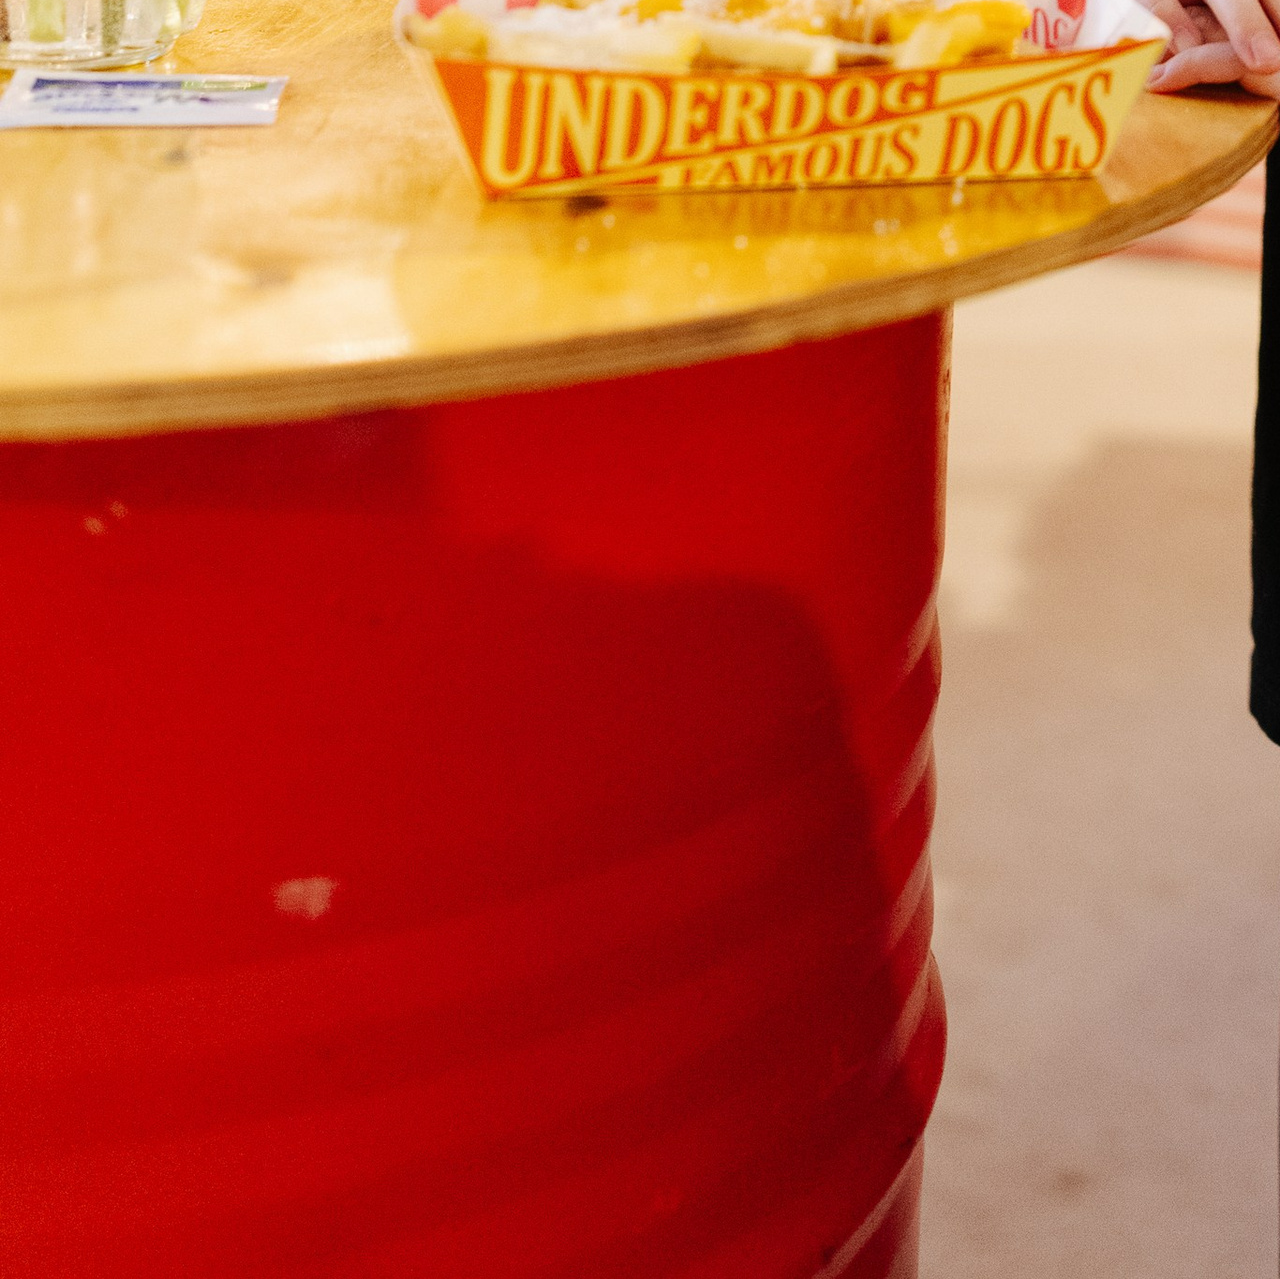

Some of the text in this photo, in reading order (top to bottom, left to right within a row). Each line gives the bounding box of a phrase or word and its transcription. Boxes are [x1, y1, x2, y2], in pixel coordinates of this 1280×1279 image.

[483, 65, 931, 188] UNDERDOG
[677, 69, 1113, 188] FAMOUS DOGS
